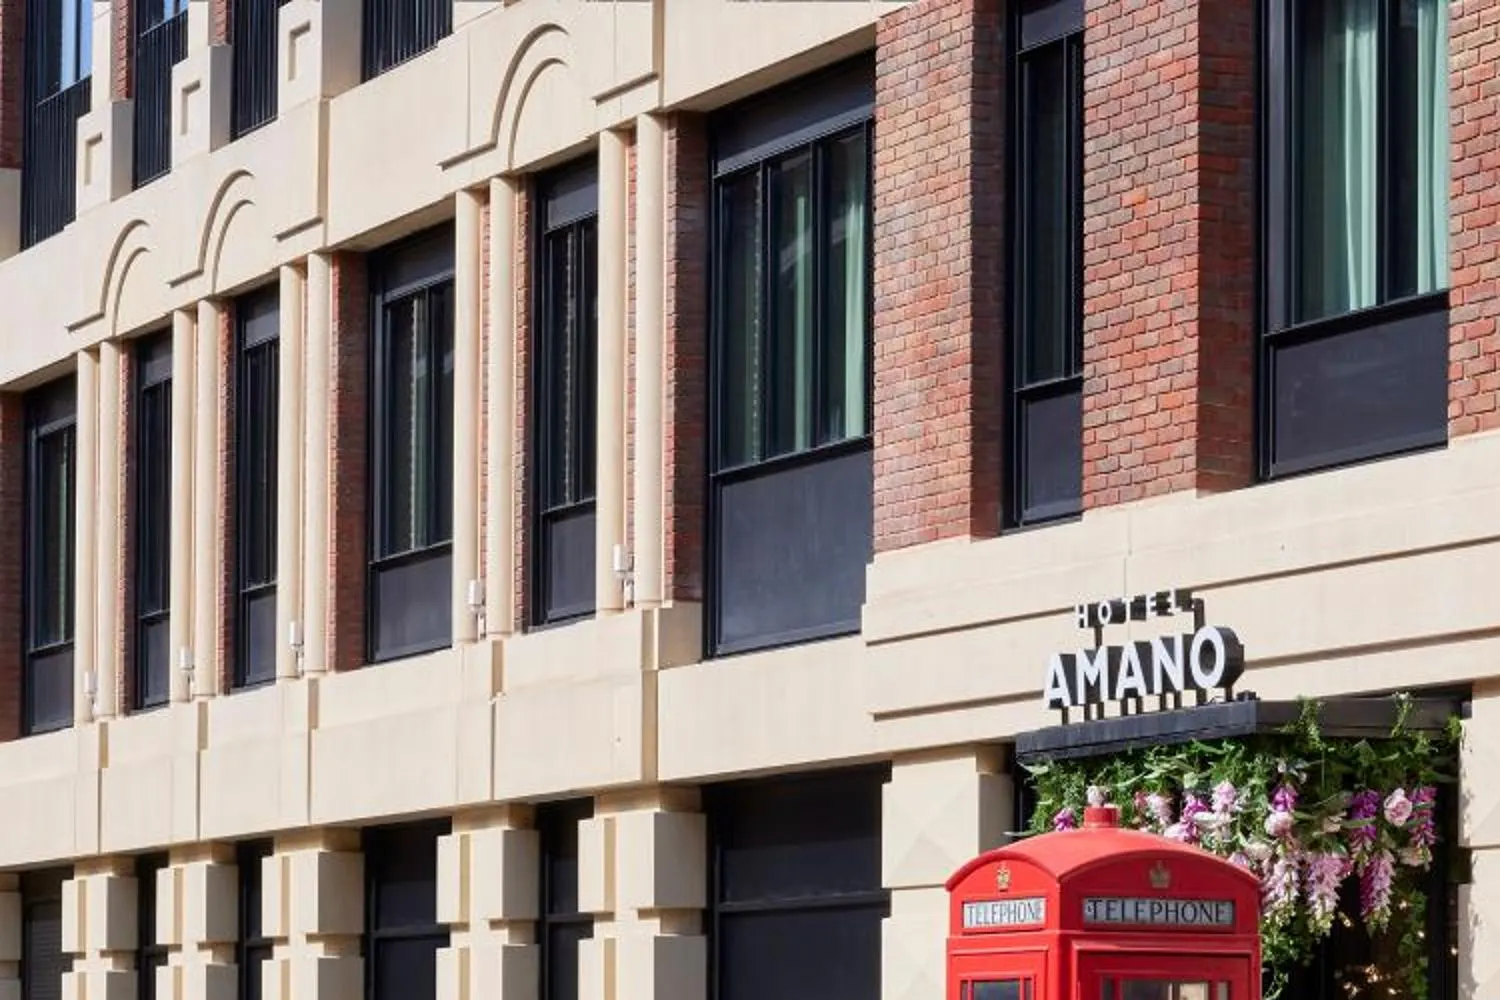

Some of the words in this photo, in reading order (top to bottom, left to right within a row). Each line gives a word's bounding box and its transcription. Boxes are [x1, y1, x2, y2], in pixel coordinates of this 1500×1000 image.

[1074, 589, 1186, 629] HOTEL
[1043, 625, 1226, 708] AMANO
[965, 901, 1043, 925] TELEPHONE
[1088, 899, 1228, 924] TELEPHONE
